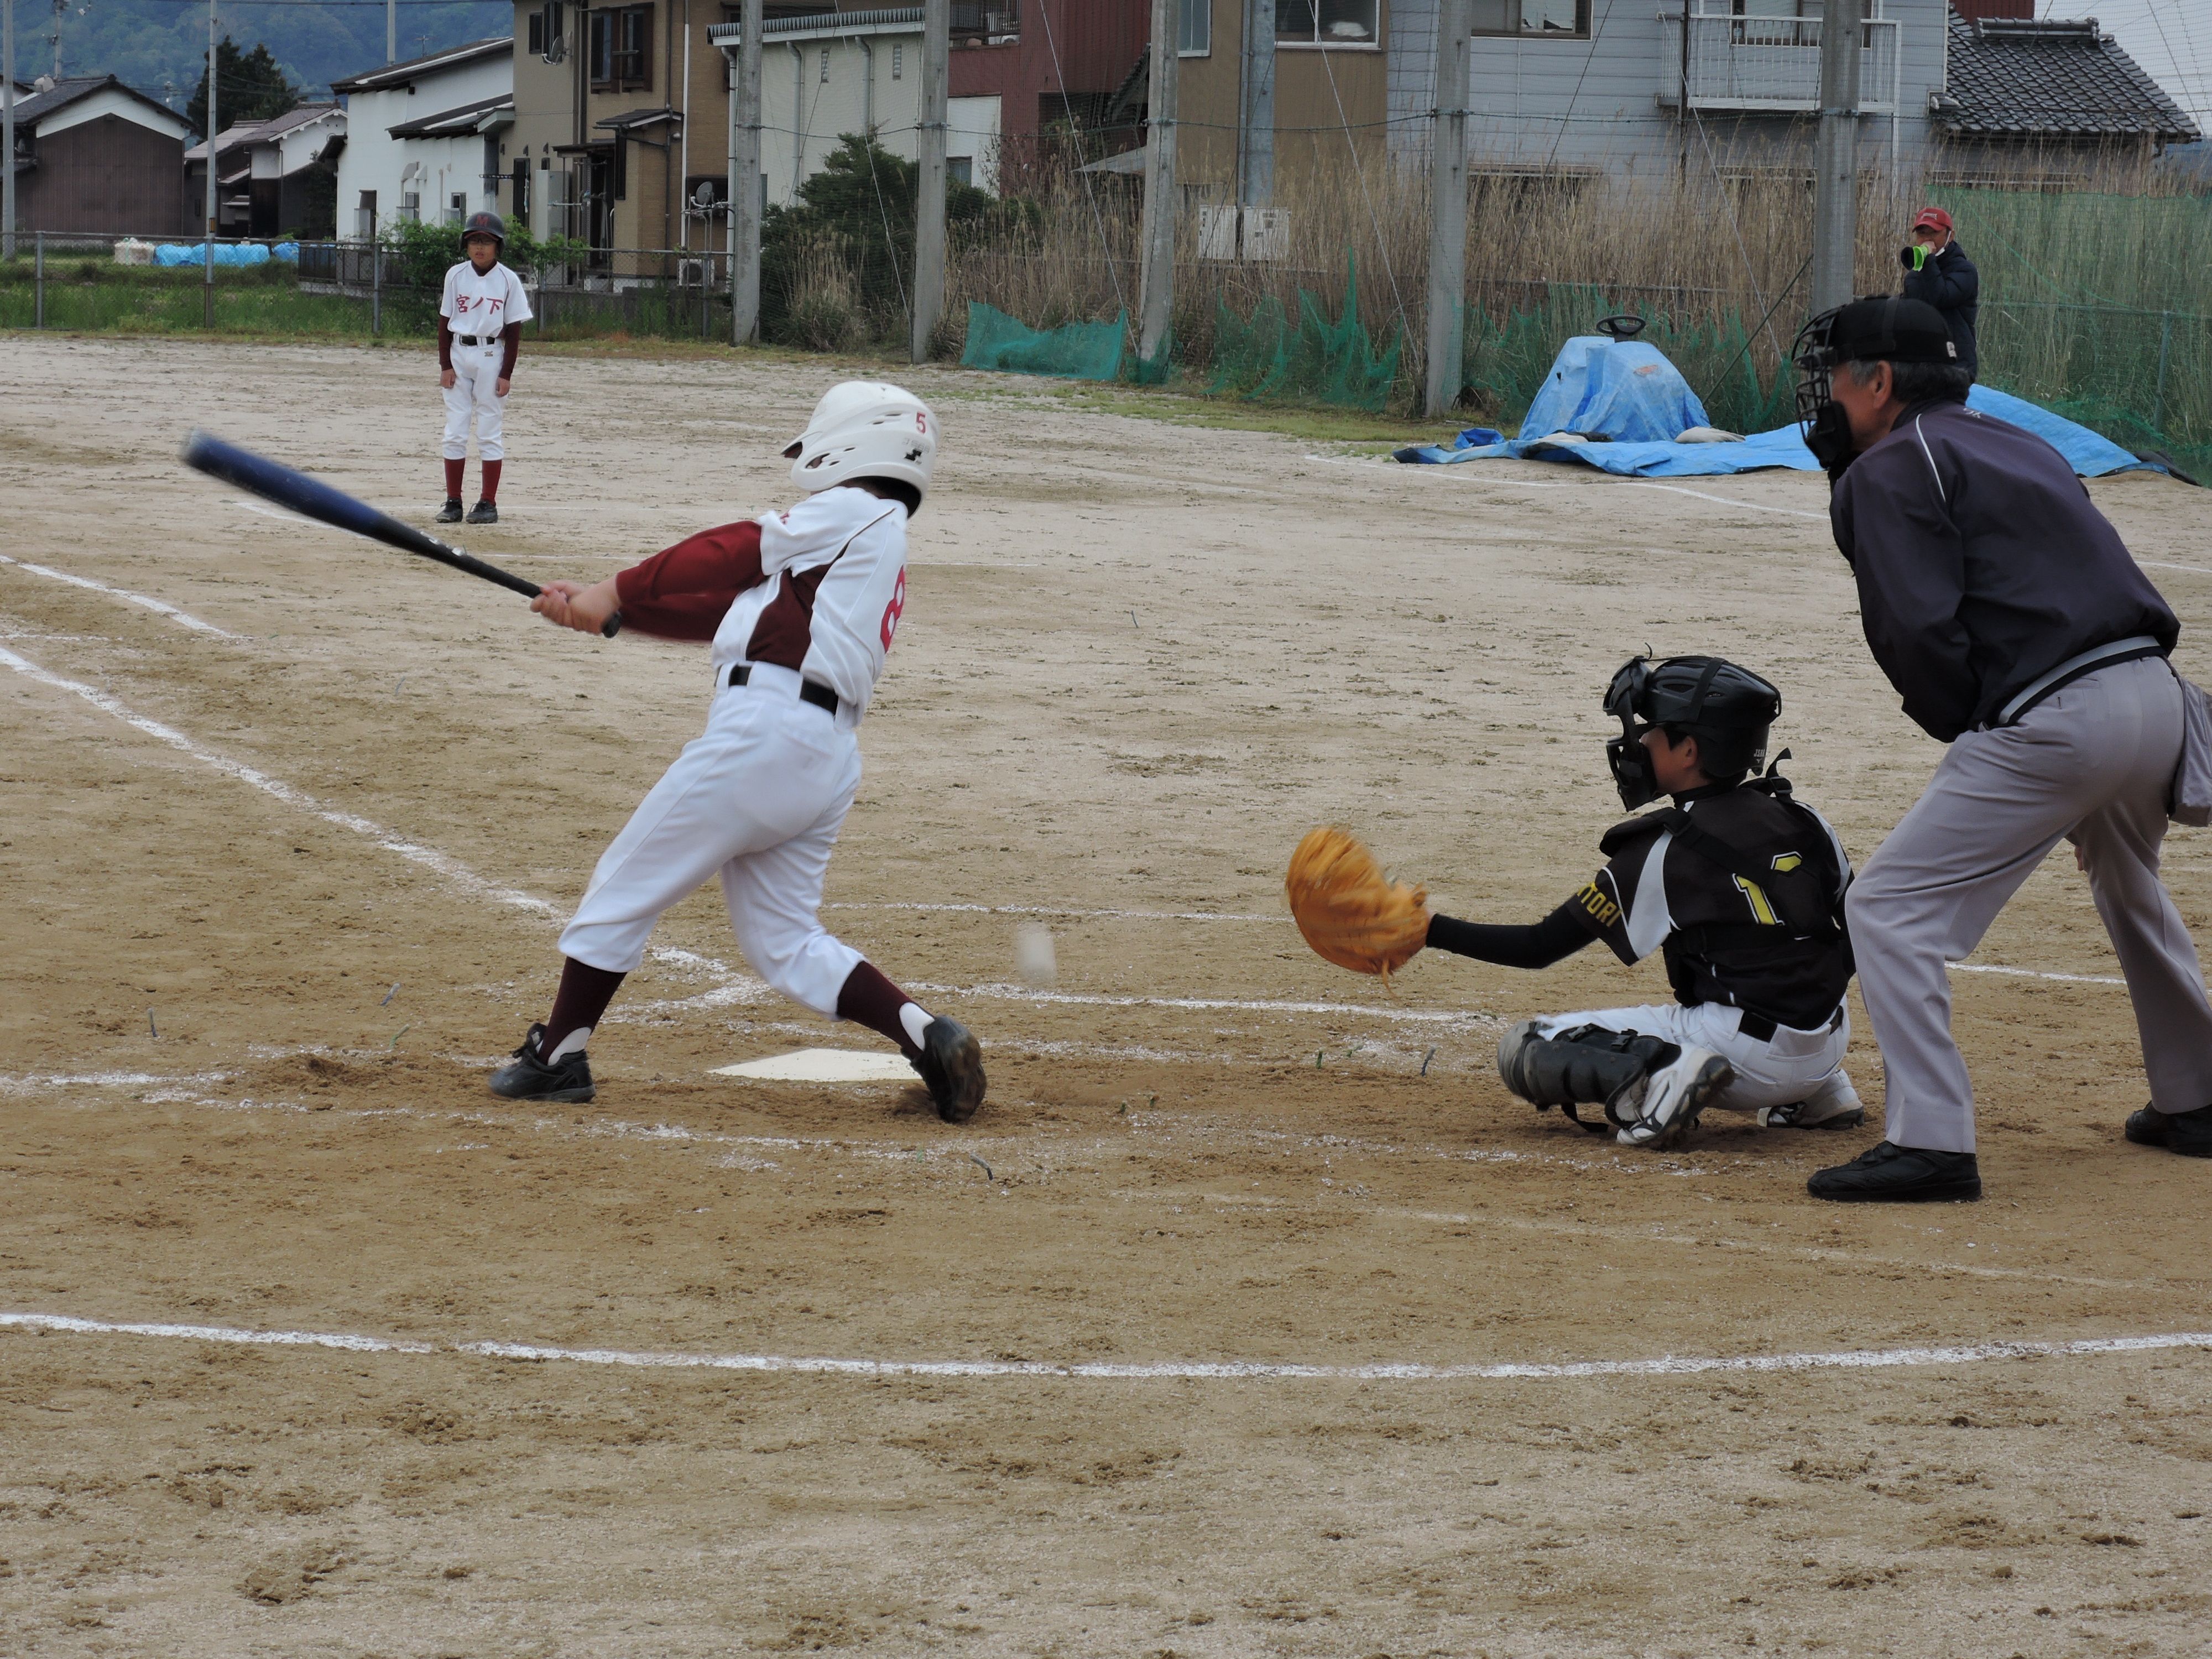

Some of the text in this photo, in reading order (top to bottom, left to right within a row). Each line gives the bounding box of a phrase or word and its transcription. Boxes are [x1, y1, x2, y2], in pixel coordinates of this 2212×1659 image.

[476, 214, 489, 227] M
[456, 294, 504, 315] 宮ノ下
[916, 412, 926, 434] 5
[879, 564, 905, 654] 8
